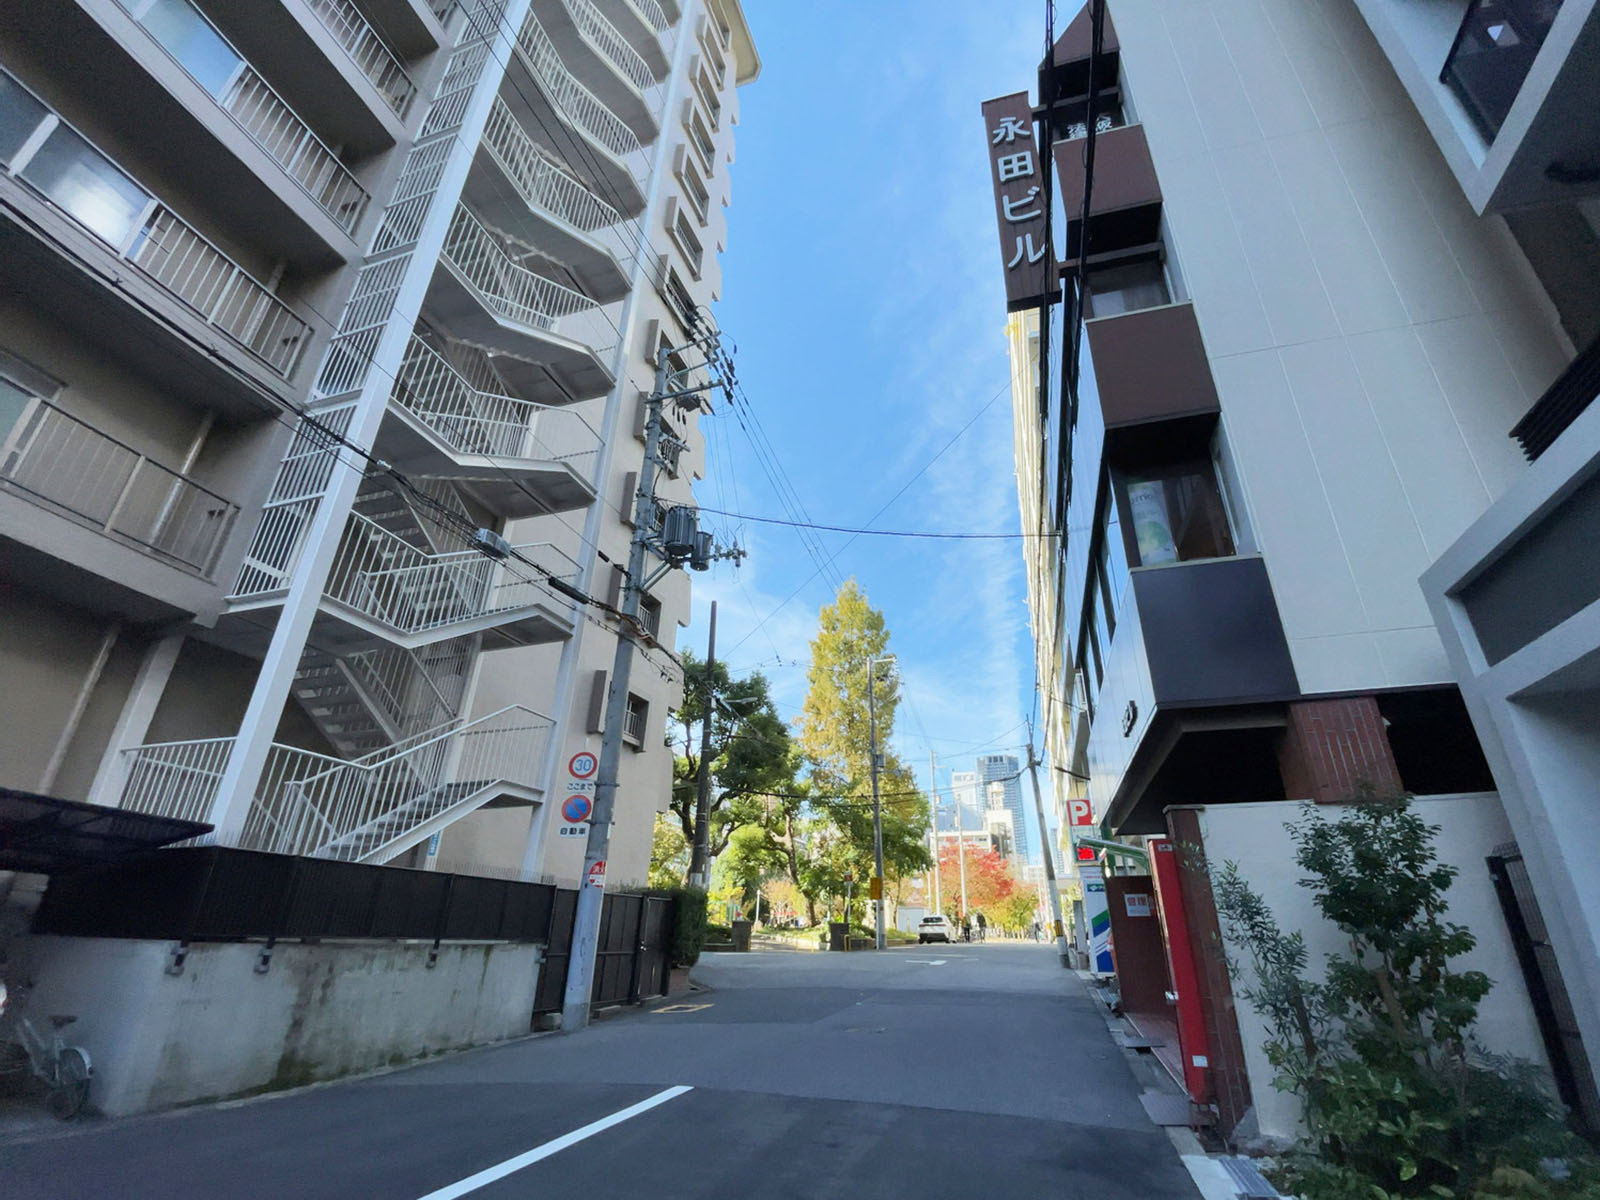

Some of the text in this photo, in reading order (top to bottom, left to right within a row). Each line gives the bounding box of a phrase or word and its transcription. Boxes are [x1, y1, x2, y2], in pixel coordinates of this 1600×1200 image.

[993, 117, 1046, 270] 永田ビル
[574, 758, 592, 772] 30
[567, 782, 593, 791] ここまで
[1069, 800, 1089, 825] P
